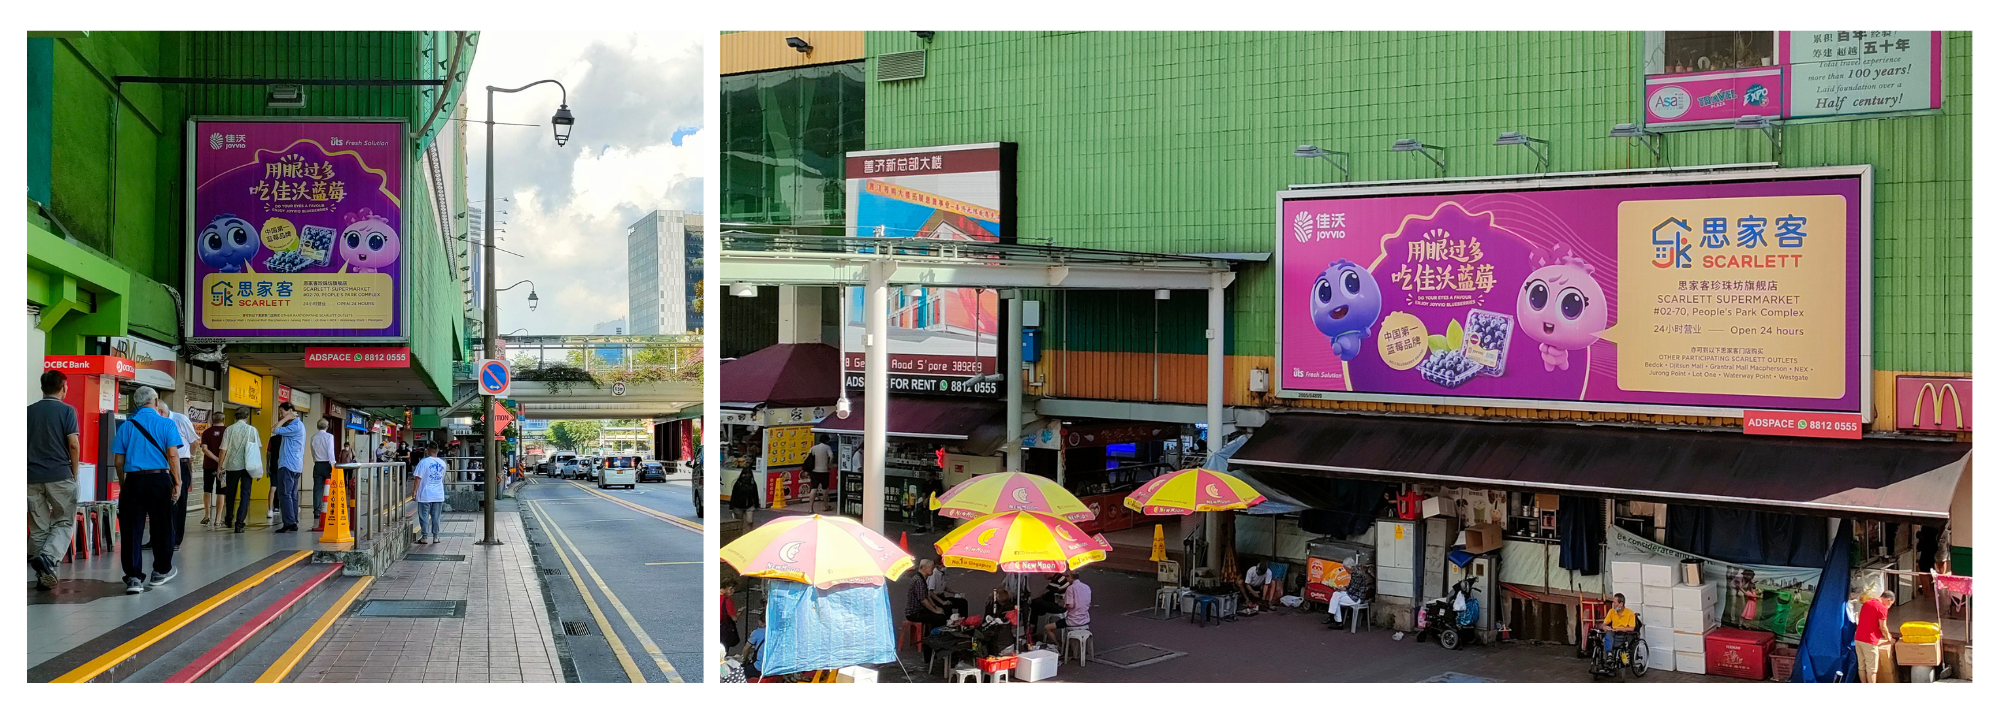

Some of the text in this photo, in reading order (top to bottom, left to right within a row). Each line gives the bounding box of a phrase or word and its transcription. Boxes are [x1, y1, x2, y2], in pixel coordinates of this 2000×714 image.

[1864, 39, 1910, 54] 五十年
[1863, 57, 1901, 66] experience
[1848, 68, 1871, 78] 100
[1872, 64, 1911, 80] years!
[1835, 83, 1876, 94] foundation
[1655, 95, 1677, 107] Asa
[1697, 89, 1738, 107] TRAVEL
[1743, 88, 1768, 106] EXPO
[1815, 93, 1903, 110] Half century!
[225, 134, 246, 143] 佳沃
[264, 160, 336, 180] 用眼过多
[864, 155, 942, 173] 善济新总部大楼
[249, 180, 347, 203] 吃佳沃蓝莓
[1316, 213, 1346, 228] 佳沃
[1316, 231, 1346, 241] JOYVIO
[1700, 214, 1807, 248] 思家客
[1407, 237, 1484, 263] 用眼过多
[1703, 254, 1803, 268] SCARLETT
[1391, 264, 1497, 293] 吃佳沃蓝莓
[1678, 280, 1778, 291] 思家客珍珠坊旗舰店
[237, 280, 293, 297] 思家客
[1657, 294, 1800, 304] SCARLETT SUPERMARKET
[1654, 307, 1804, 318] #02-70, People's Park Complex
[1384, 326, 1418, 342] 中国第一
[1653, 324, 1702, 334] 24小时营业
[1730, 326, 1757, 336] Open
[1776, 327, 1804, 335] hours
[1386, 337, 1422, 355] 蓝莓品牌
[891, 378, 909, 389] FOR
[912, 379, 937, 390] RENT
[975, 382, 996, 393] 0555
[1748, 418, 1857, 431] ADSPACE 8812 0555
[1617, 533, 1627, 541] Be
[1628, 537, 1673, 555] considerate
